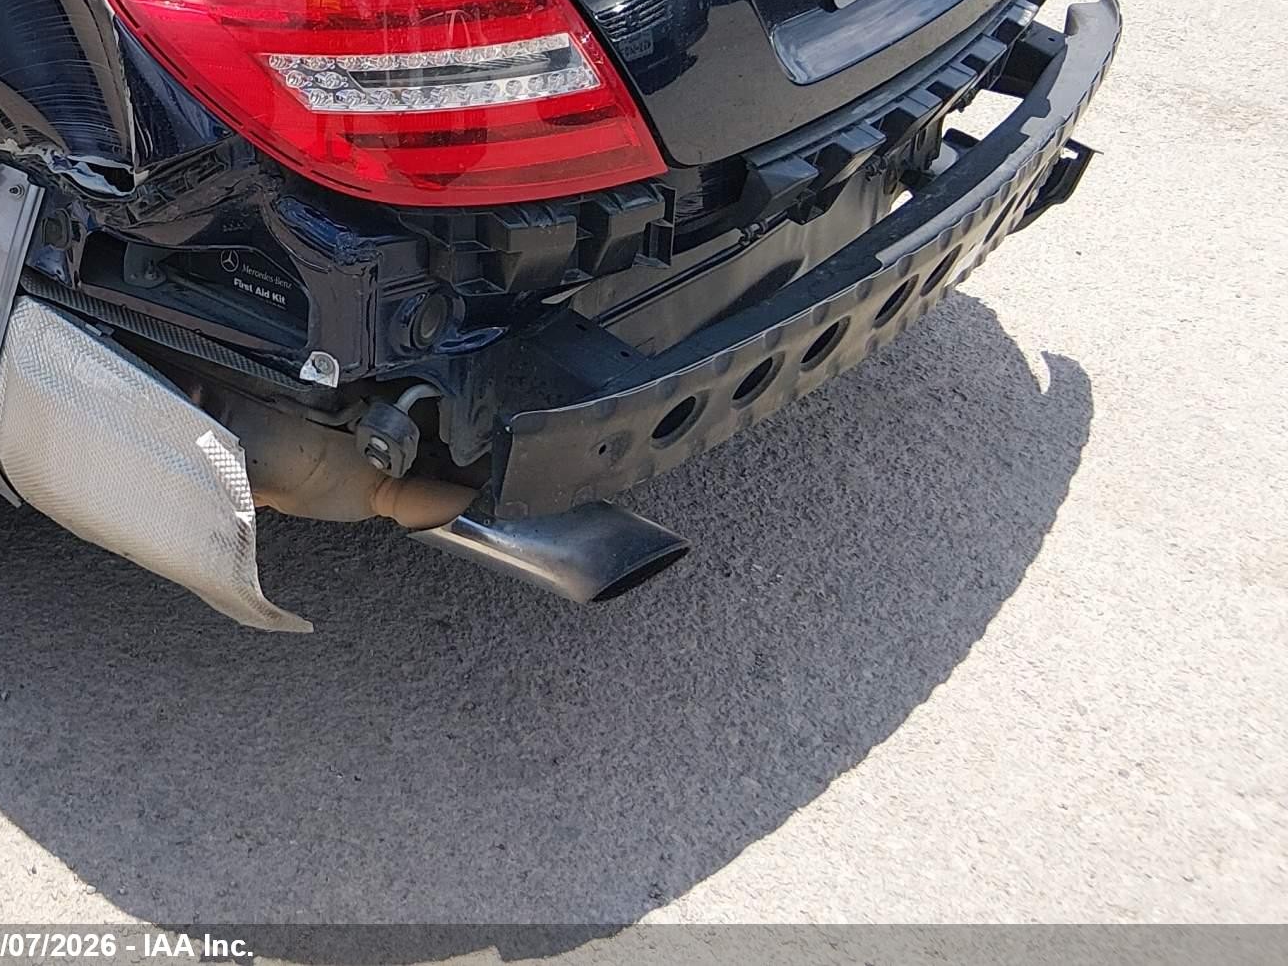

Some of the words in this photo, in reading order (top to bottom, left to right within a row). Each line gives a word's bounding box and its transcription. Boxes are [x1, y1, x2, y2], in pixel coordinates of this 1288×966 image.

[233, 277, 254, 293] First
[255, 286, 270, 299] Aid
[272, 292, 287, 305] Kit
